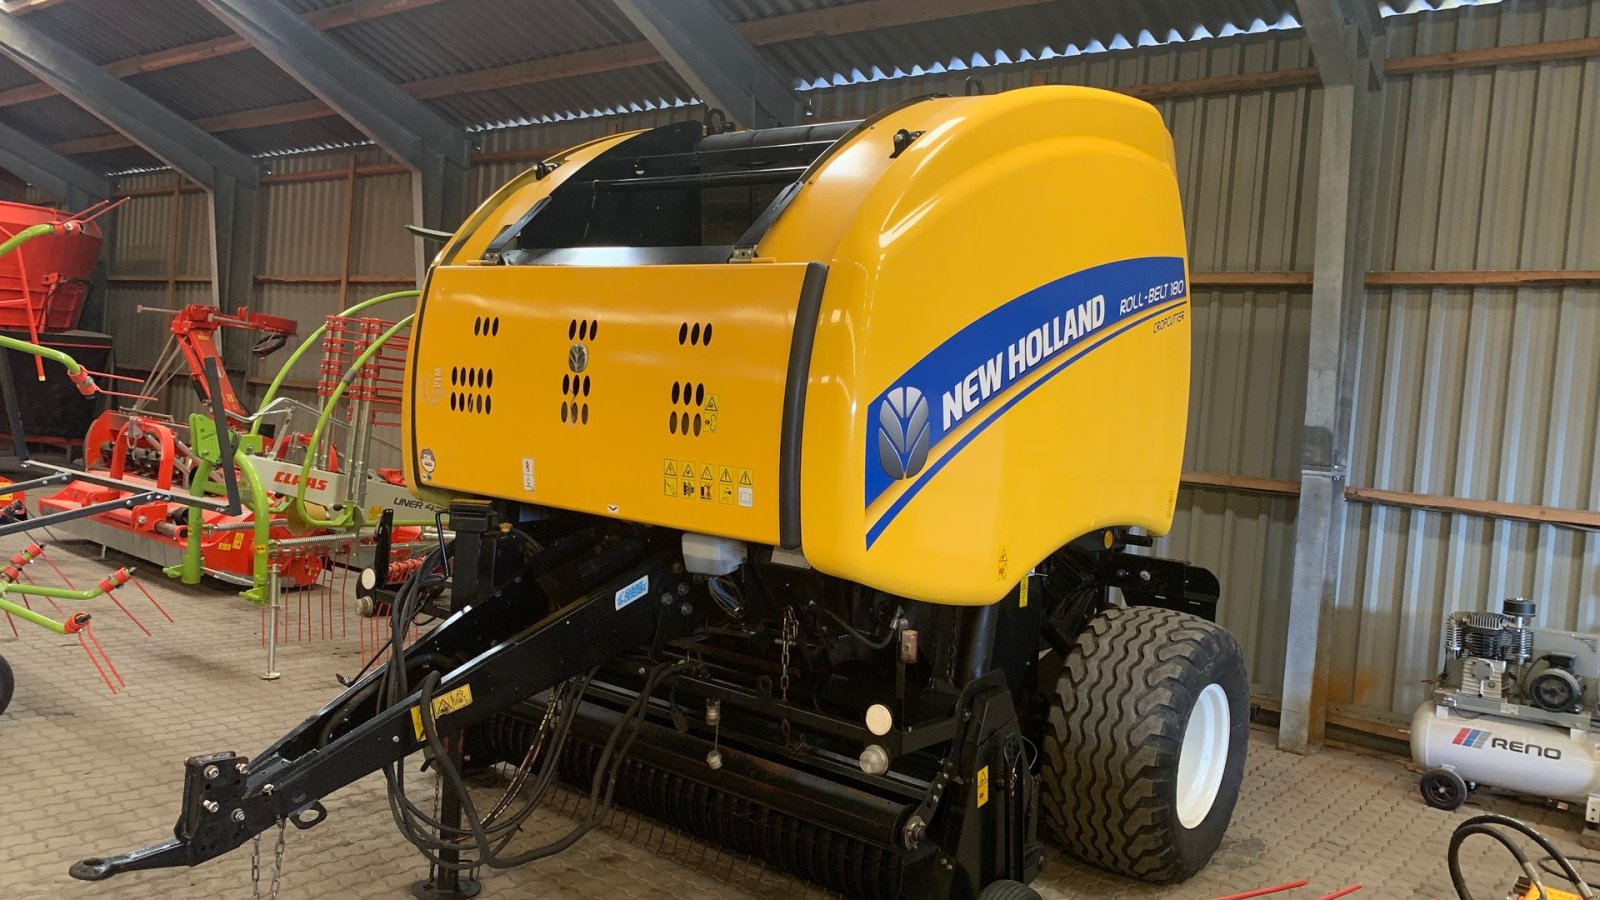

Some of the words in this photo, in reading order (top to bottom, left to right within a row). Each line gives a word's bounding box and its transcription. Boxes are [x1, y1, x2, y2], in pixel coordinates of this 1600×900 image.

[1170, 280, 1184, 296] 180
[942, 352, 1003, 431] NEW
[1008, 294, 1105, 381] HOLLAND
[393, 497, 424, 510] LINER
[1491, 737, 1562, 760] RENO
